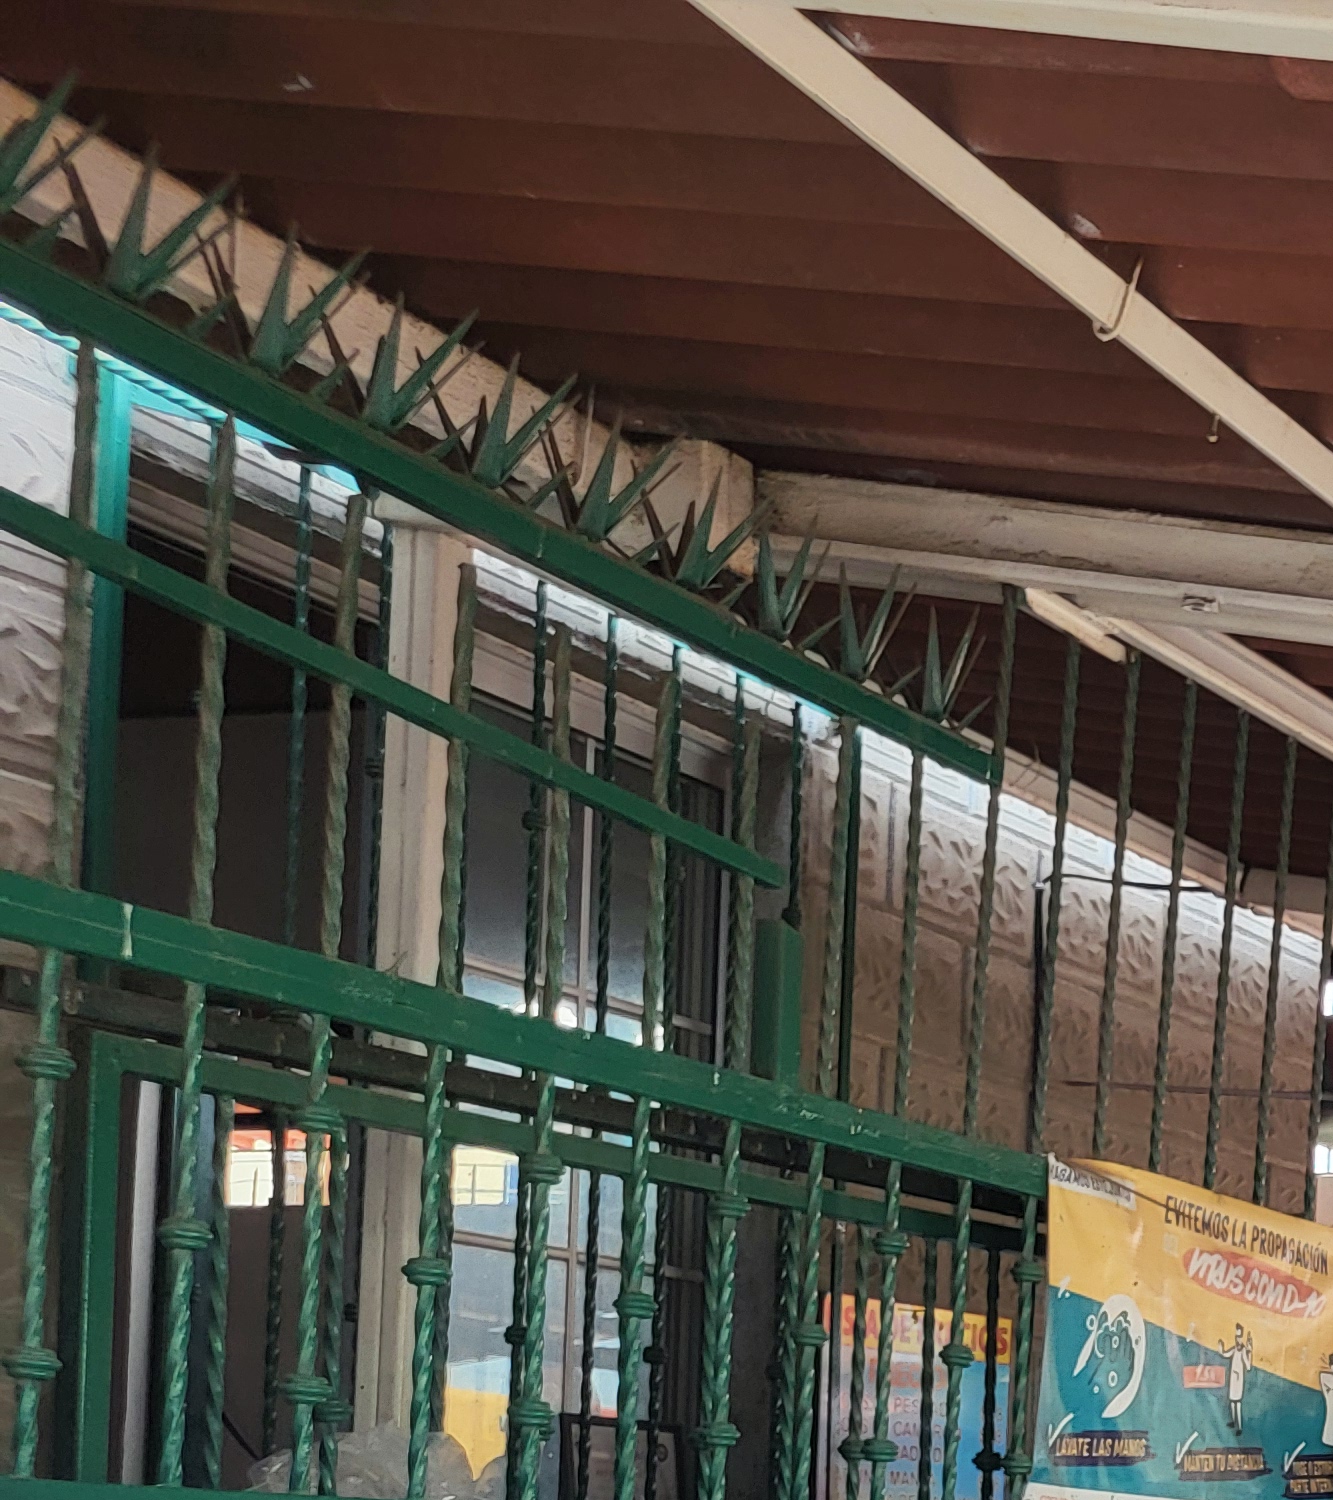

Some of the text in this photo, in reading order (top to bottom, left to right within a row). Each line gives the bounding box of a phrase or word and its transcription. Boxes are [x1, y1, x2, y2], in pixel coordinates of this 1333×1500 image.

[1164, 1195, 1328, 1276] EVITEMOS LA PROPAGACIÓN
[1187, 1247, 1246, 1295] VIRUS
[1092, 1438, 1112, 1457] LAS
